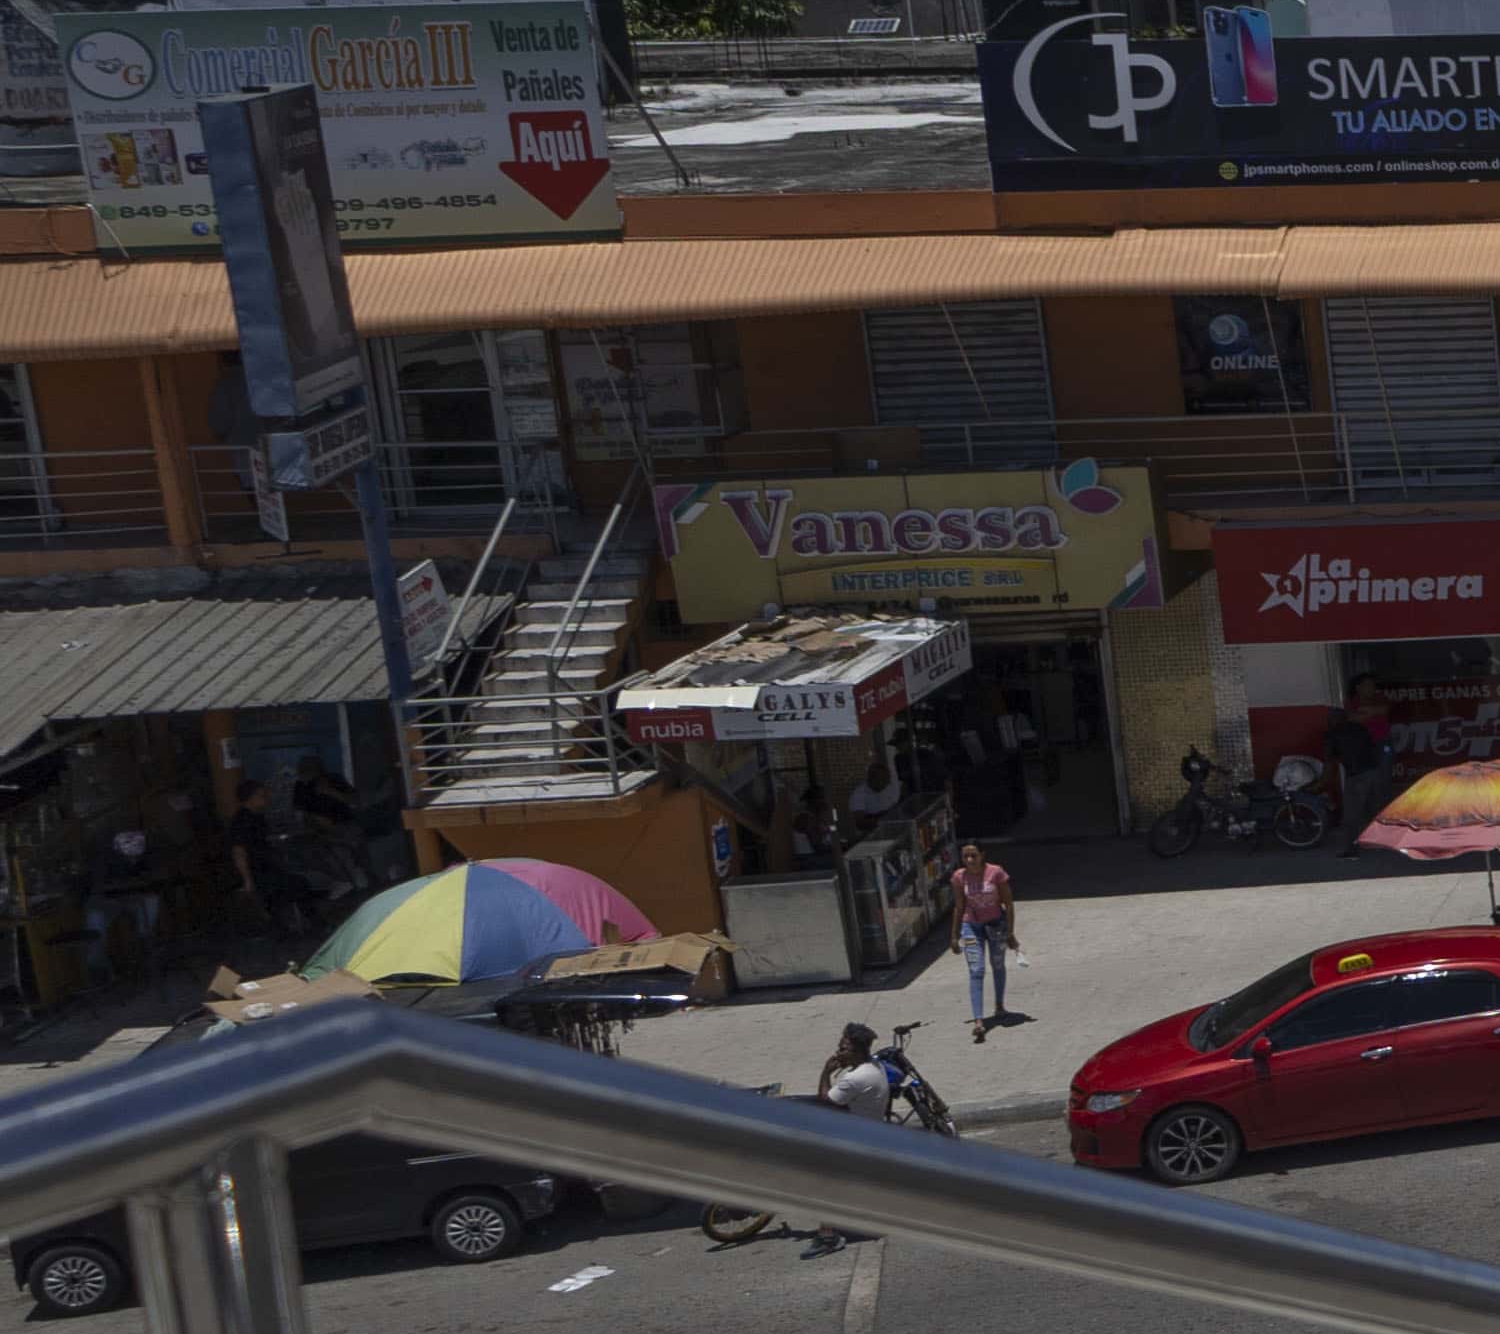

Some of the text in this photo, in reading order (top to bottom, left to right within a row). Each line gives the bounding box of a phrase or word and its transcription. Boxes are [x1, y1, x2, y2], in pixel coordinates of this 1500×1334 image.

[488, 18, 580, 53] Venta de
[161, 16, 478, 99] Comercial García III
[502, 68, 585, 103] Pañales
[1331, 110, 1365, 135] TU
[1370, 108, 1468, 134] ALIADO
[518, 118, 585, 172] Aquí
[1243, 160, 1375, 181] jpsmartphones.com
[1210, 354, 1280, 371] ONLINE
[720, 489, 1070, 559] Vanessa
[831, 569, 972, 591] INTERPRICE
[1309, 553, 1352, 580] La
[1309, 569, 1484, 612] primera
[1431, 684, 1491, 699] GANAS
[640, 718, 705, 740] nubia
[757, 711, 817, 722] CELL
